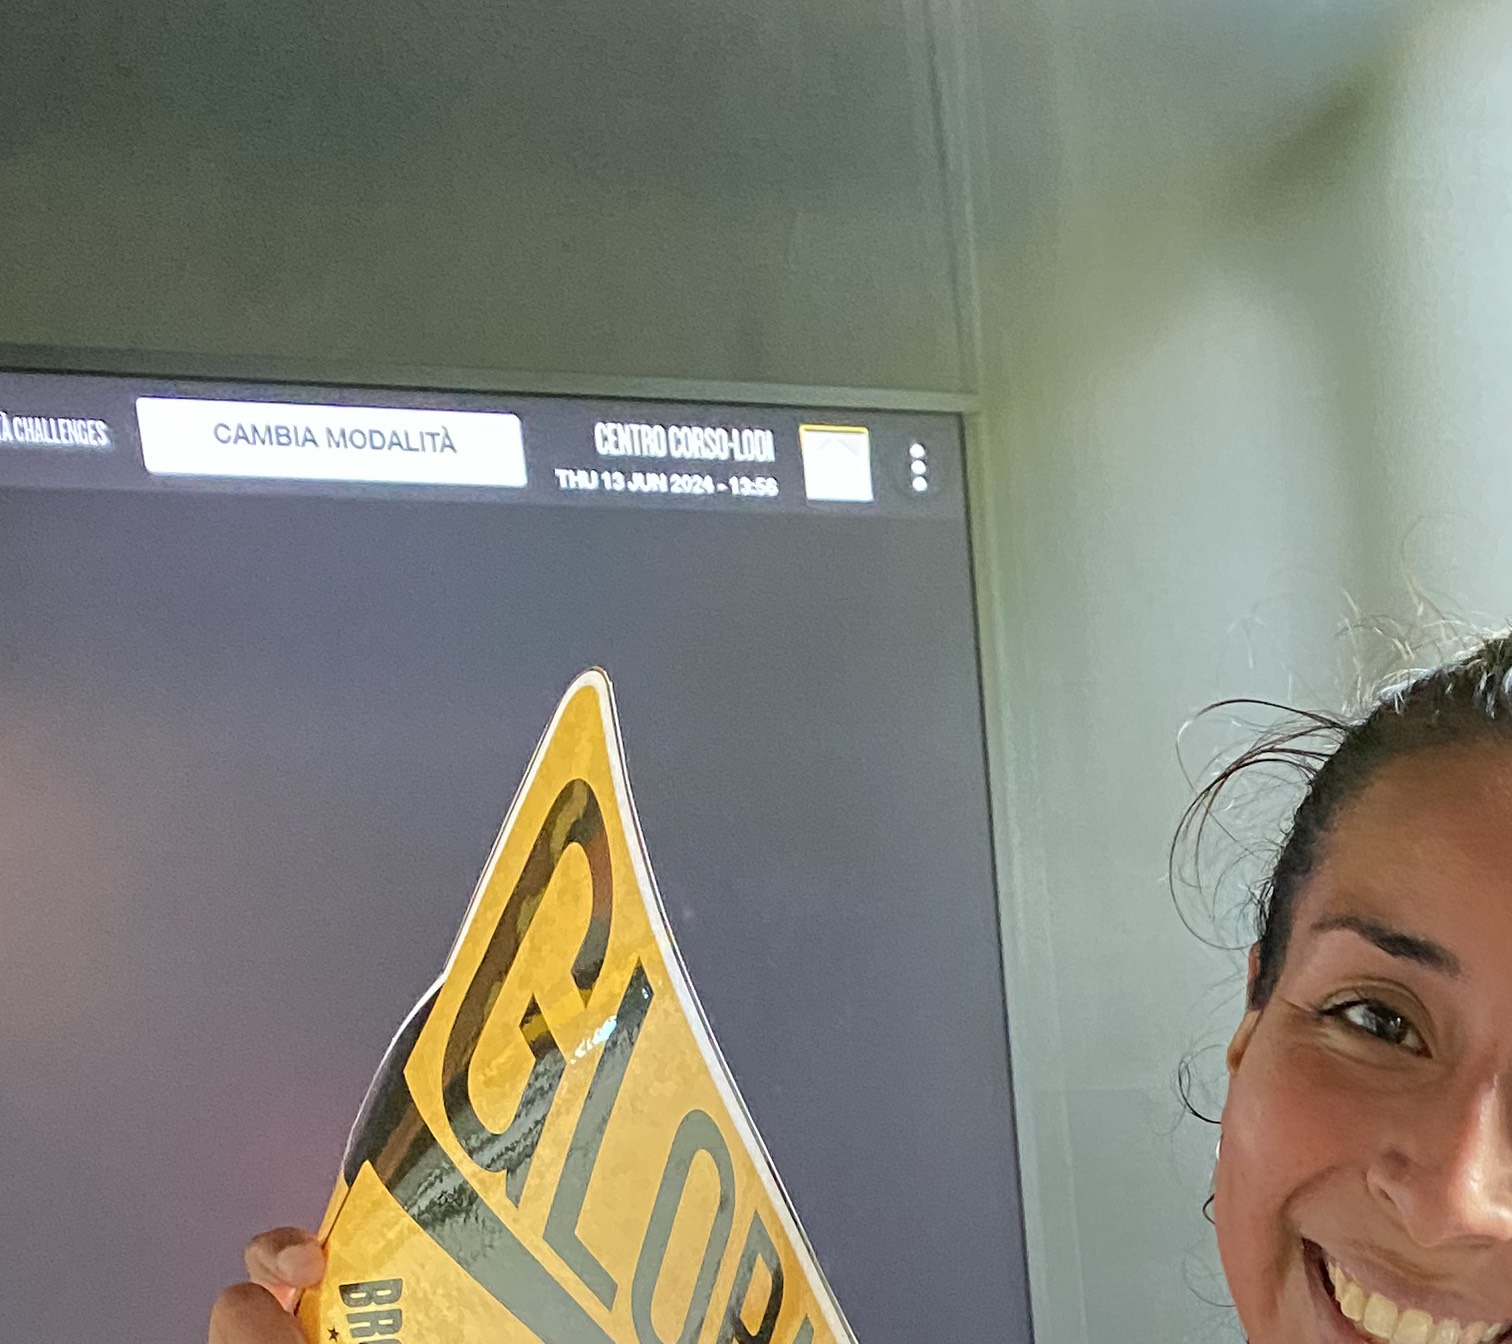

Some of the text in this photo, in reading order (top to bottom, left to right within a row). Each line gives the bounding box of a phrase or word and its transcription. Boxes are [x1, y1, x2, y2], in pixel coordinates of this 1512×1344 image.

[12, 416, 110, 447] CHALLENGES
[213, 422, 458, 454] CAMBIA MODALITÀ
[594, 421, 667, 458] CENTRO
[554, 468, 599, 490] THU
[601, 470, 626, 491] 13
[627, 472, 669, 493] JUN
[669, 473, 716, 495] 2024
